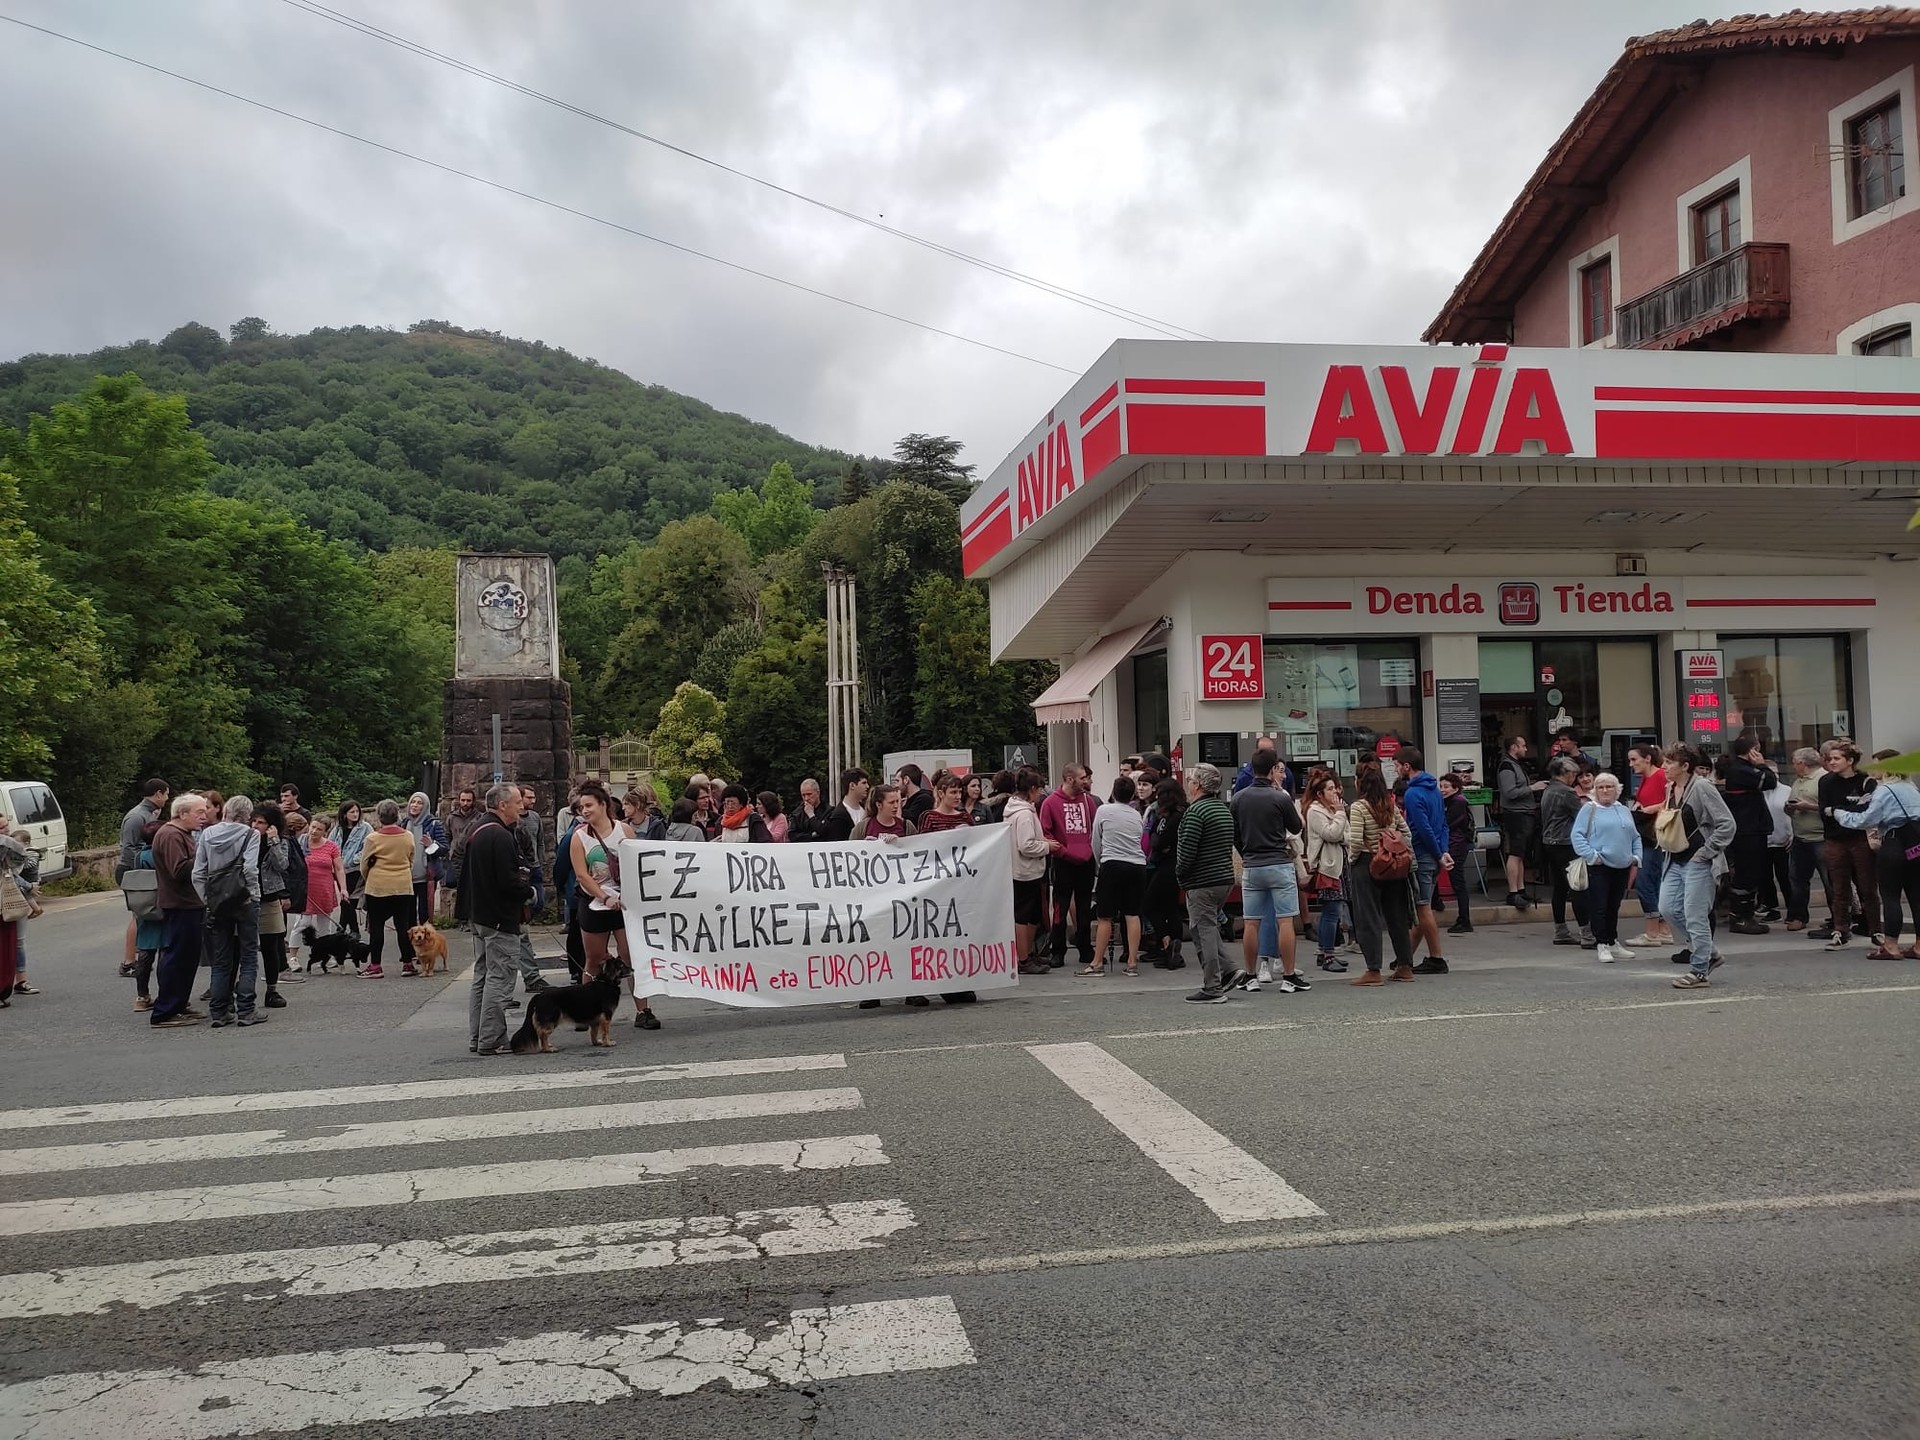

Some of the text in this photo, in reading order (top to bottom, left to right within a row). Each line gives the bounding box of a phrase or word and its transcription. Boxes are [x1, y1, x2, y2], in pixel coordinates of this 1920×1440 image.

[1366, 583, 1674, 614] Denda Tienda
[1208, 641, 1256, 678] 24
[1208, 680, 1258, 693] HORAS
[638, 849, 700, 902] EZ
[769, 969, 798, 989] eta
[808, 950, 894, 990] EUROPA
[910, 940, 1017, 981] ERRUDUN!
